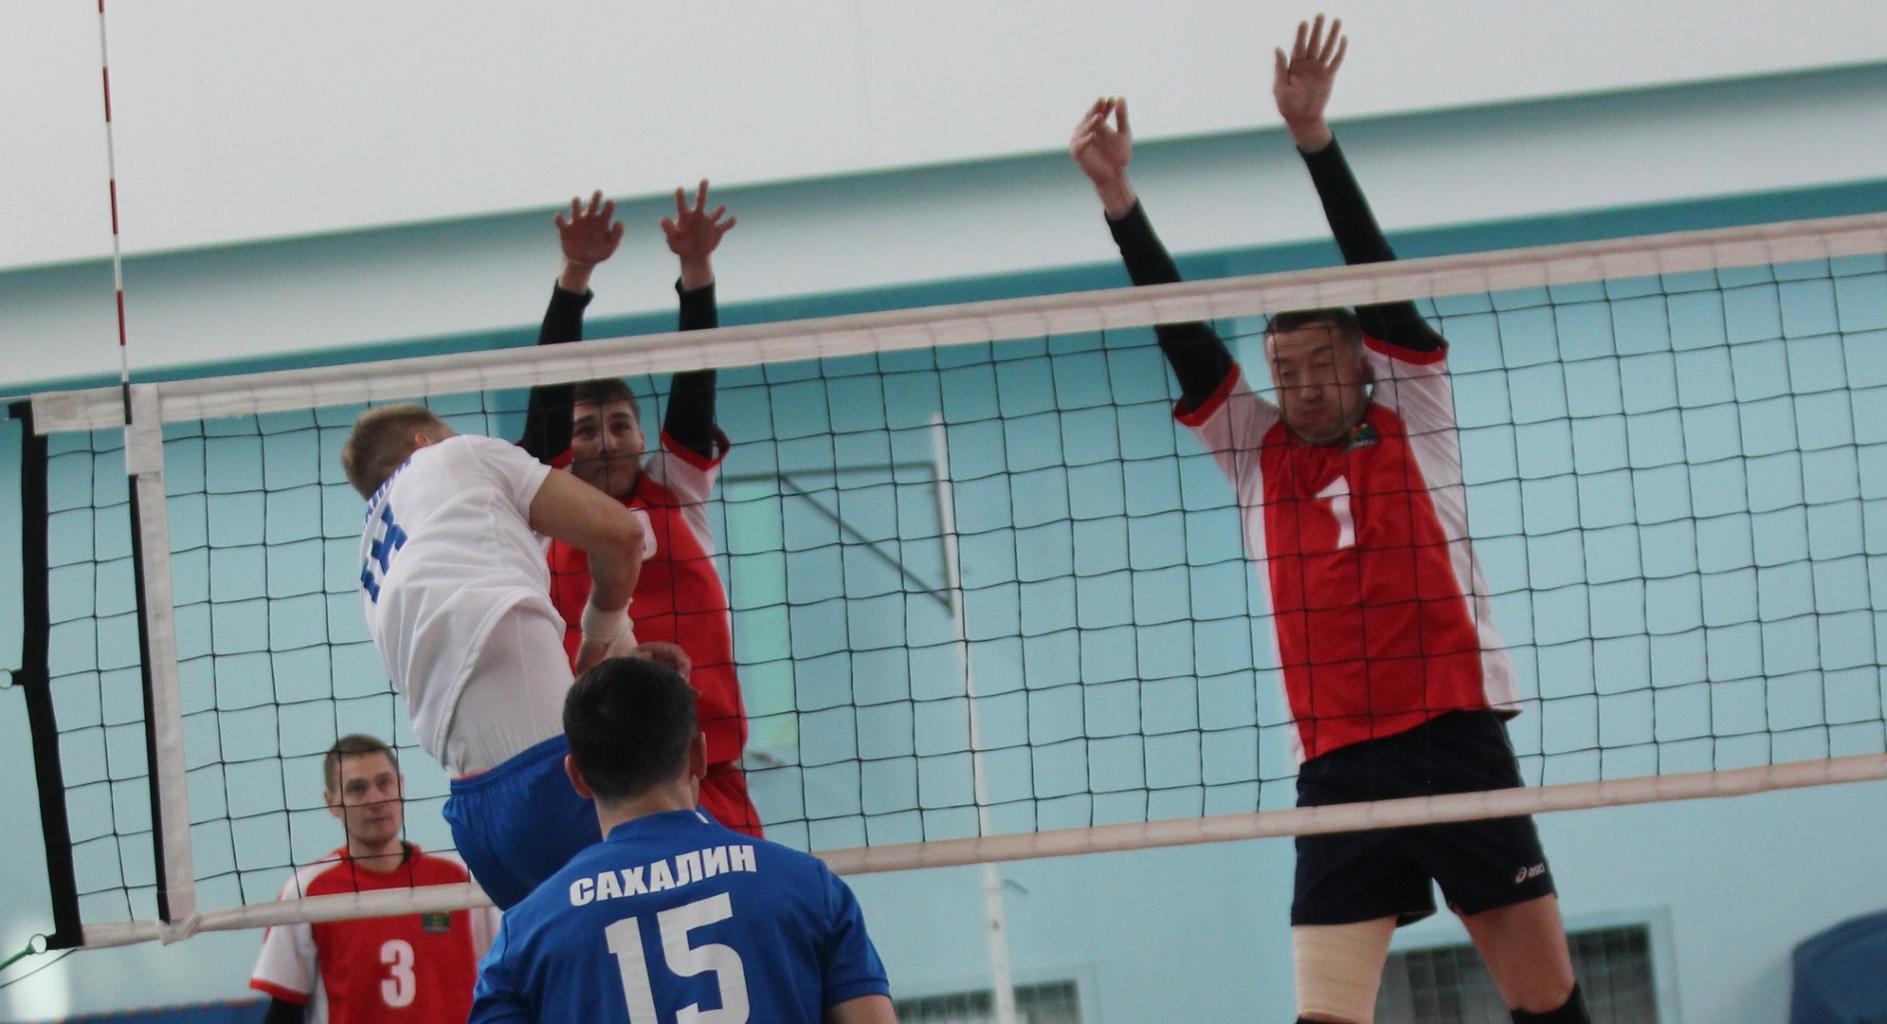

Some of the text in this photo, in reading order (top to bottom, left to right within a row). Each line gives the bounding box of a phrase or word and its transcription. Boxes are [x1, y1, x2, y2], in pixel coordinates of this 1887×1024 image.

[1315, 475, 1356, 549] 1
[569, 845, 757, 907] САХАЛИН
[380, 939, 416, 1008] 3
